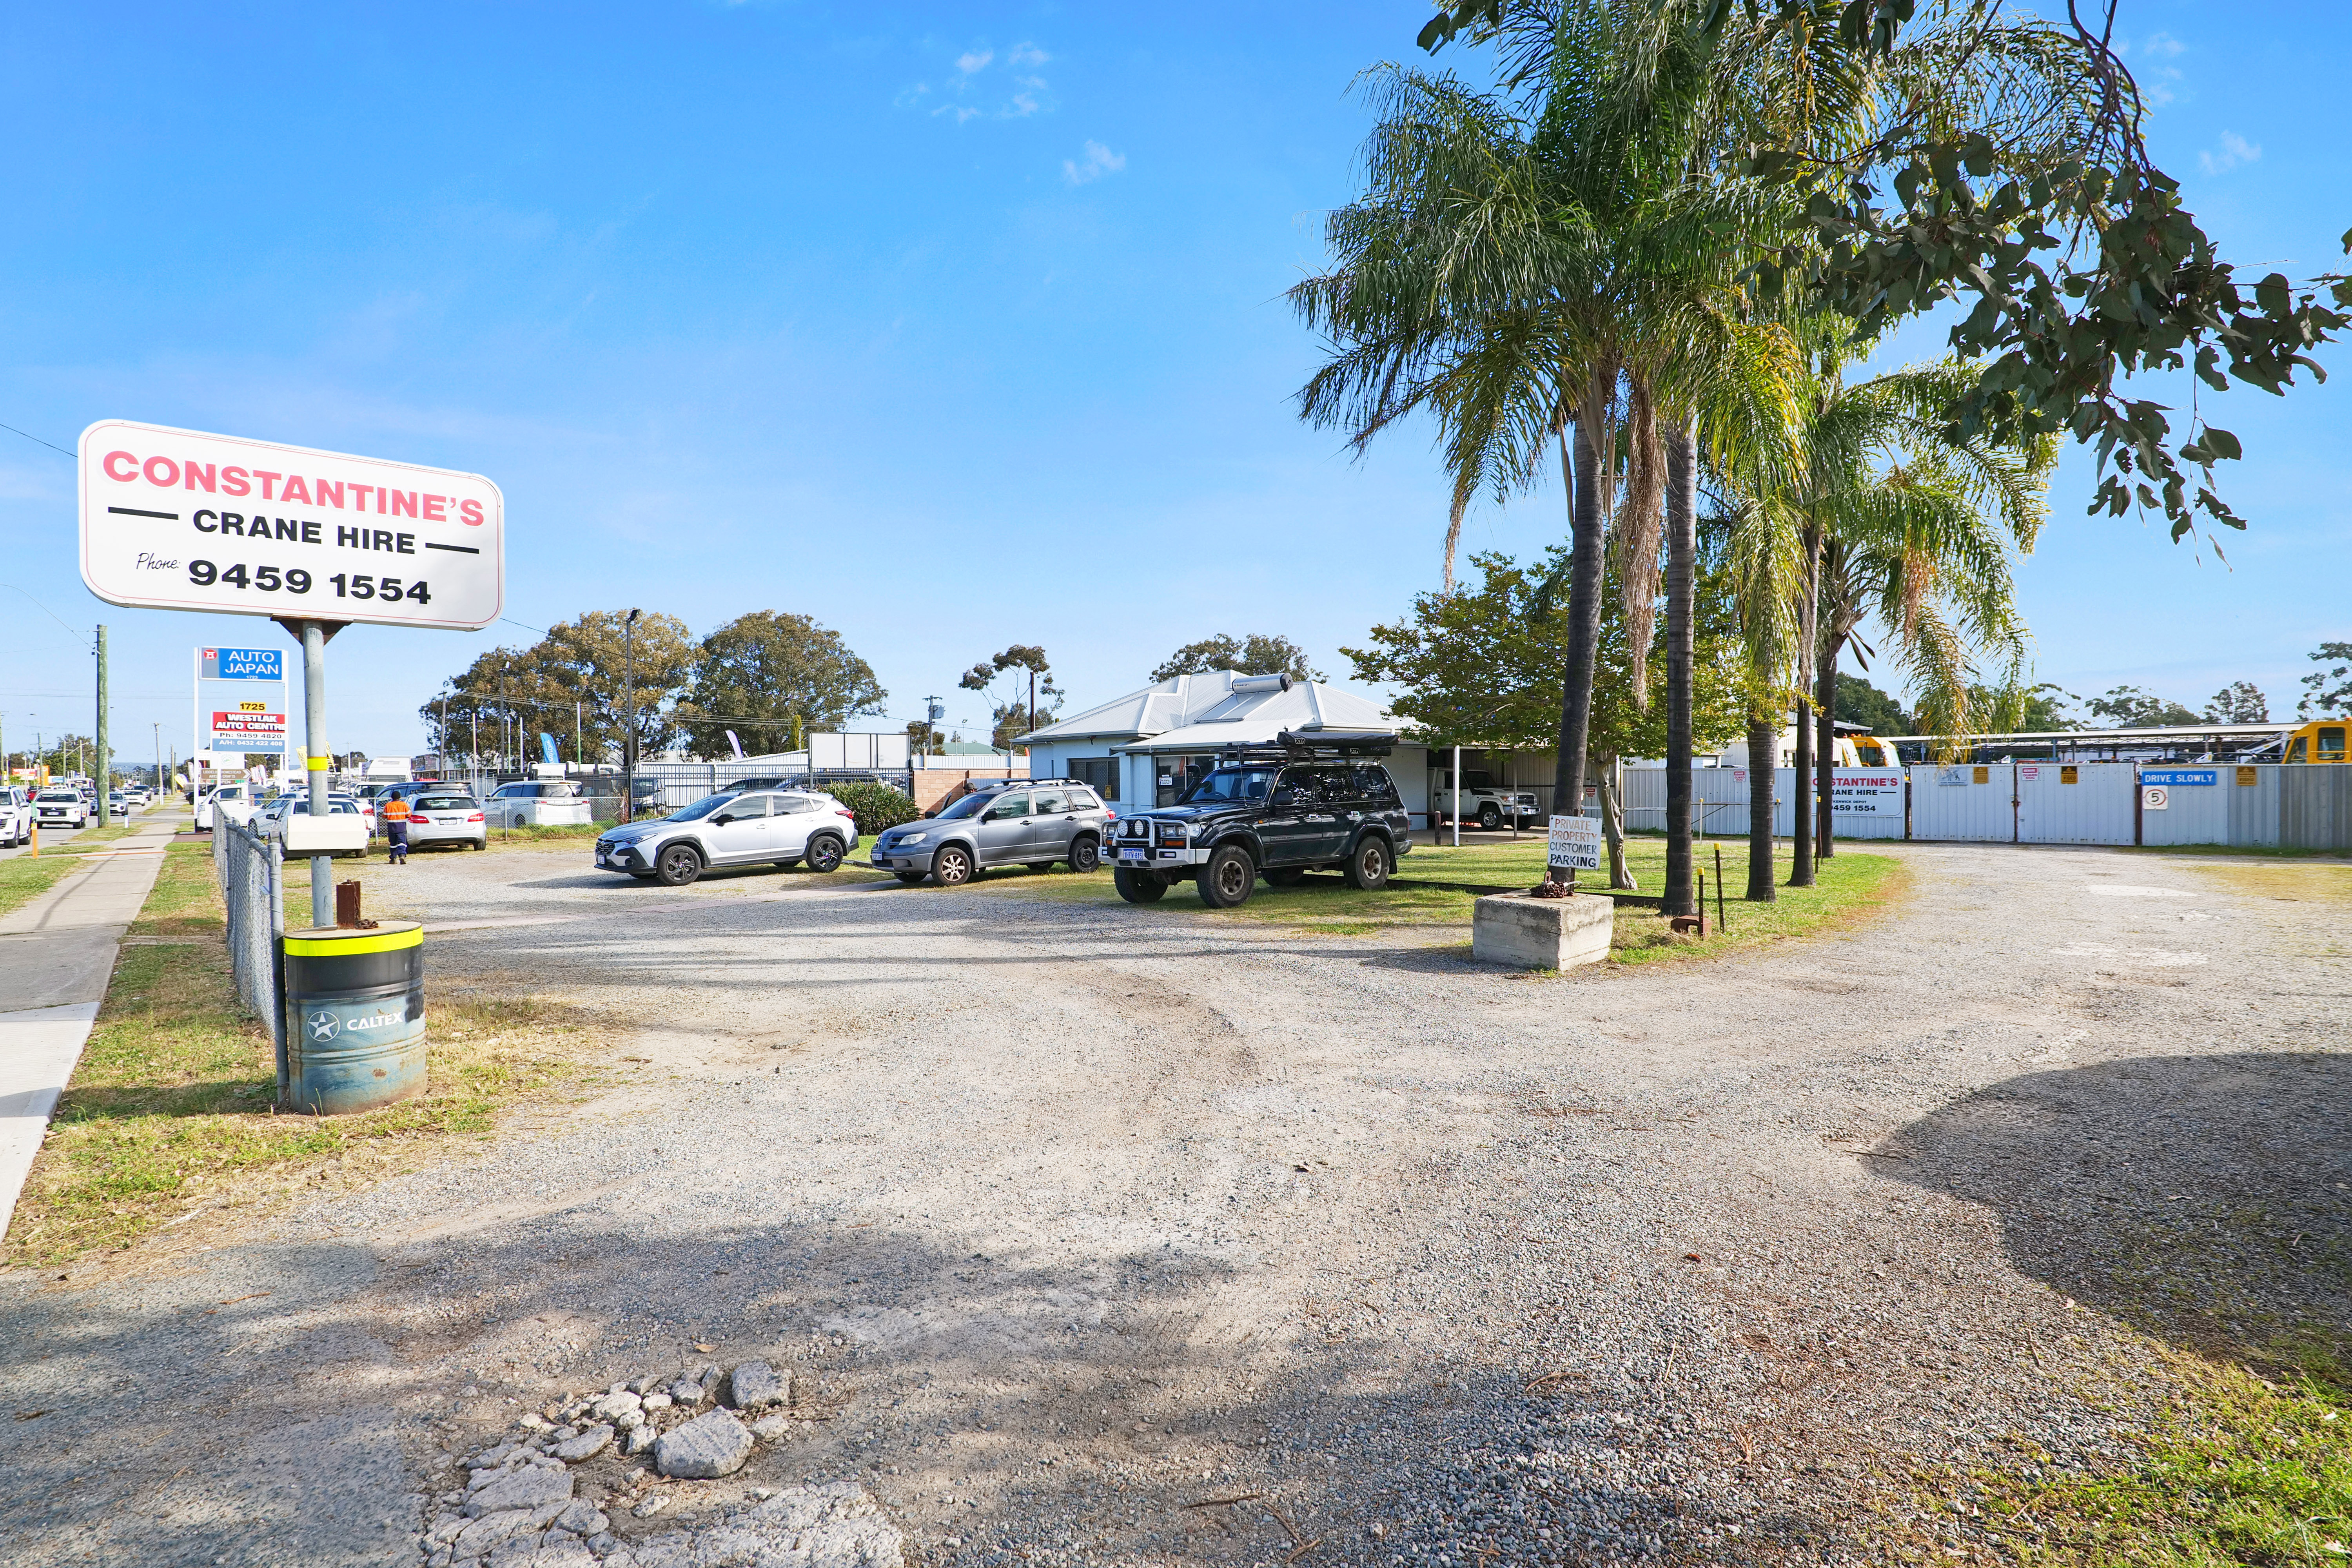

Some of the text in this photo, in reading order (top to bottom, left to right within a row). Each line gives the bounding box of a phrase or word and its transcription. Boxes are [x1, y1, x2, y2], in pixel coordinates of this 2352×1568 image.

[103, 450, 484, 526] CONSTANTINE'S
[193, 510, 415, 555] CRANE HIRE
[136, 553, 431, 604] Phone: 9459 1554
[229, 651, 274, 662] AUTO
[225, 663, 279, 675] JAPAN
[227, 714, 277, 722] WESTLAK
[247, 722, 285, 731] CENTRE
[2151, 793, 2159, 802] 5
[1555, 818, 1591, 831] PRIVATE
[1552, 830, 1597, 842] PROPERTY
[1550, 842, 1597, 855] CUSTOMER
[1550, 854, 1596, 867] PARKING
[347, 1012, 403, 1031] CALTEX
